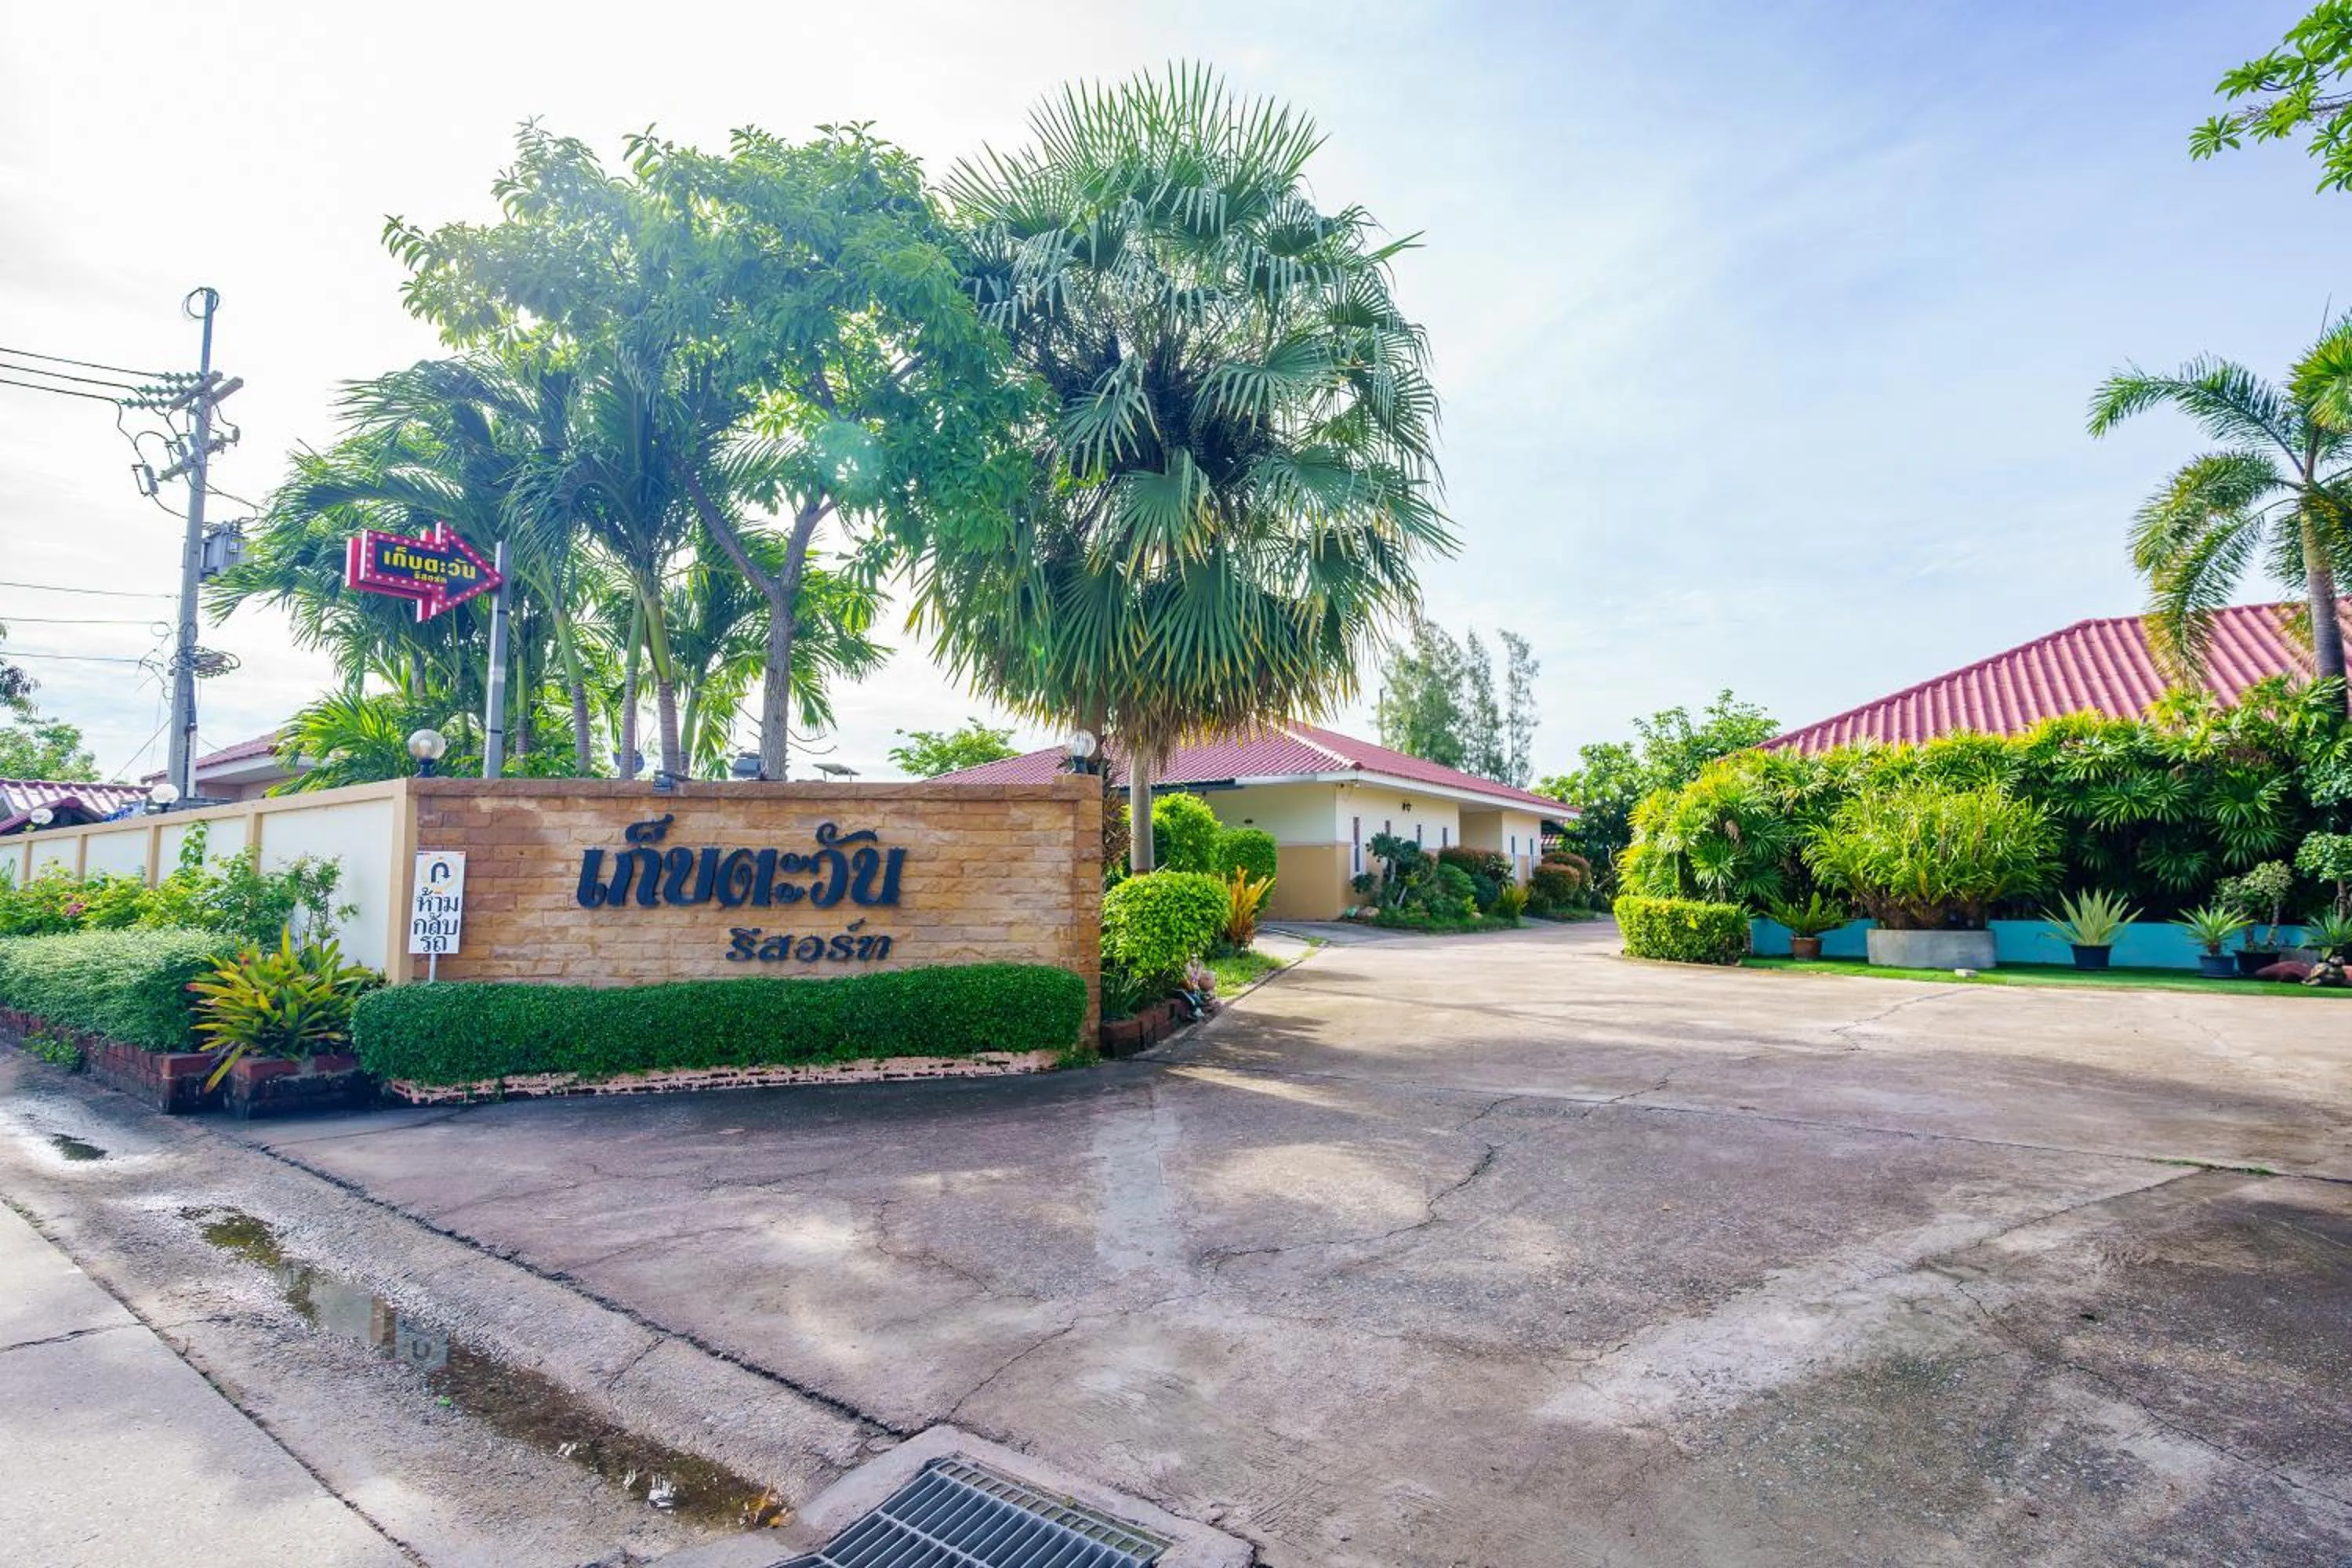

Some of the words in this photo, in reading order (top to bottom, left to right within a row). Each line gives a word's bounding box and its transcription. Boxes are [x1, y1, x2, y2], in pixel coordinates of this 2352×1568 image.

[383, 546, 476, 579] เก็บตะวัน
[576, 814, 907, 909] เก็บตะวัน
[416, 887, 459, 912] ห้าม
[420, 935, 447, 952] รถ
[725, 916, 894, 963] รีสอร์ท
